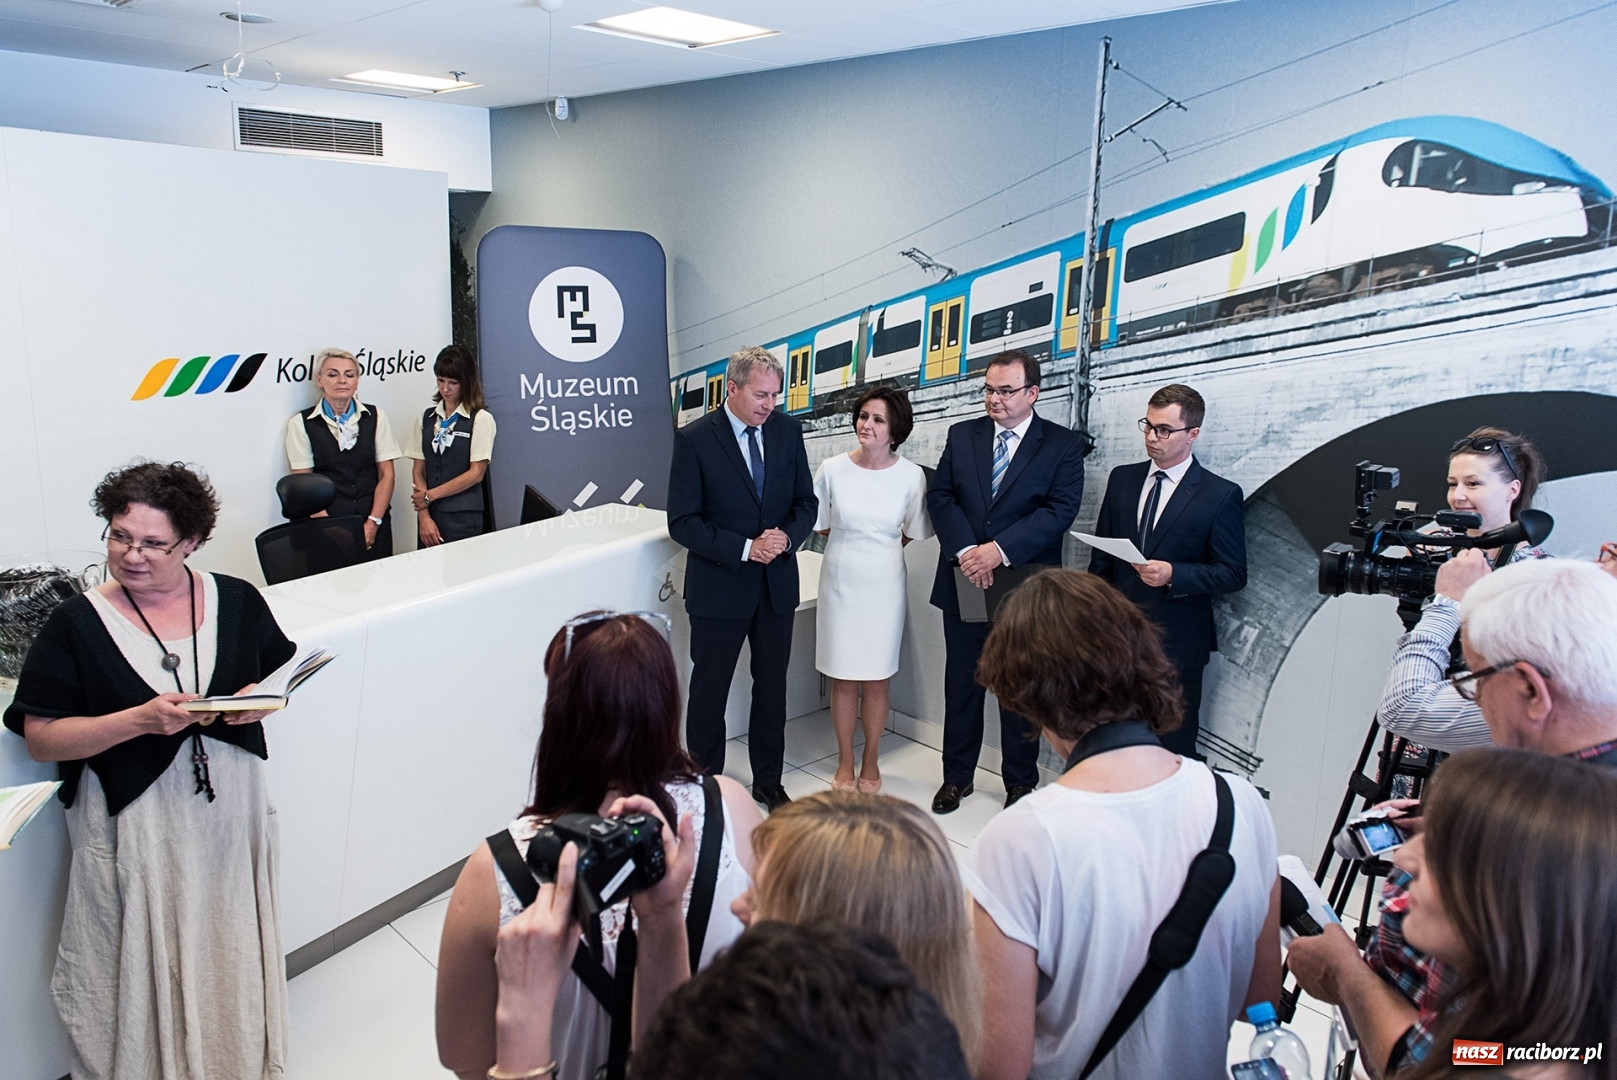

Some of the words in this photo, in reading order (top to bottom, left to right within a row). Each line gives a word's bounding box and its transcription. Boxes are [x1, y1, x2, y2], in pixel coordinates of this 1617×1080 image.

[276, 355, 316, 383] Kol
[355, 348, 426, 382] Śląskie
[519, 373, 639, 400] Muzeum
[530, 398, 633, 435] Śląskie
